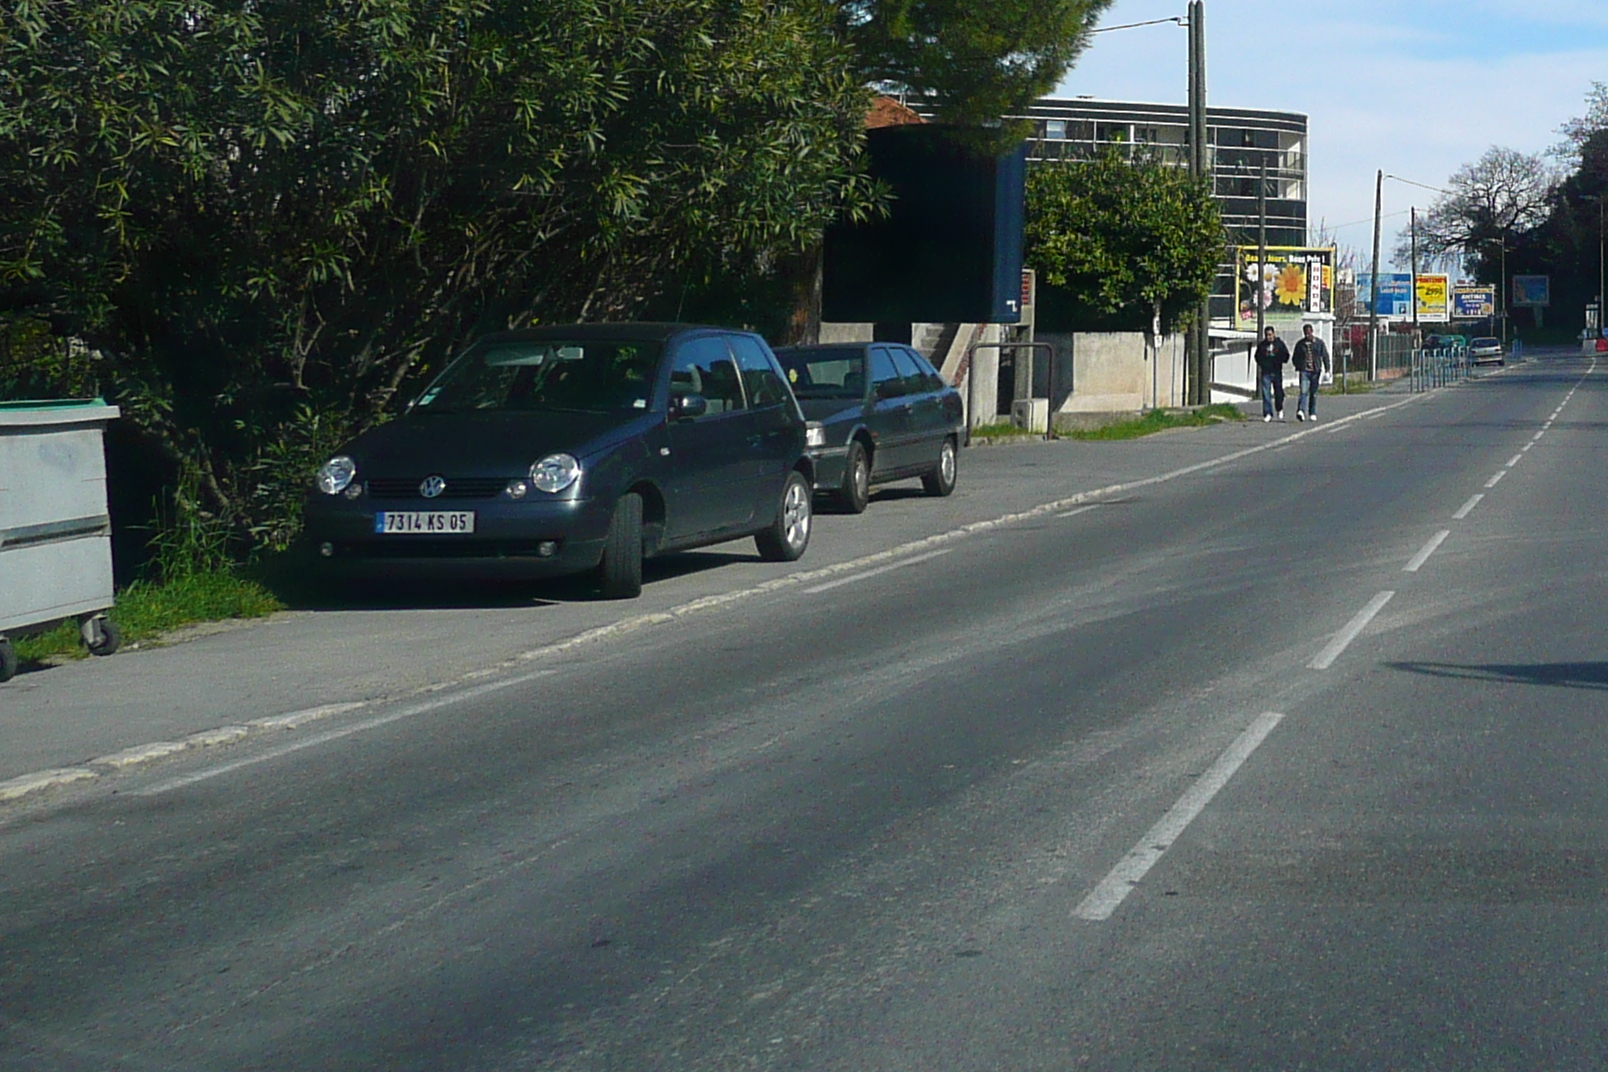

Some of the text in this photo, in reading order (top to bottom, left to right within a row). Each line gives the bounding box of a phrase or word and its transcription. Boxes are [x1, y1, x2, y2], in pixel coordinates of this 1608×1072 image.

[388, 514, 466, 530] 7314 KS 05
